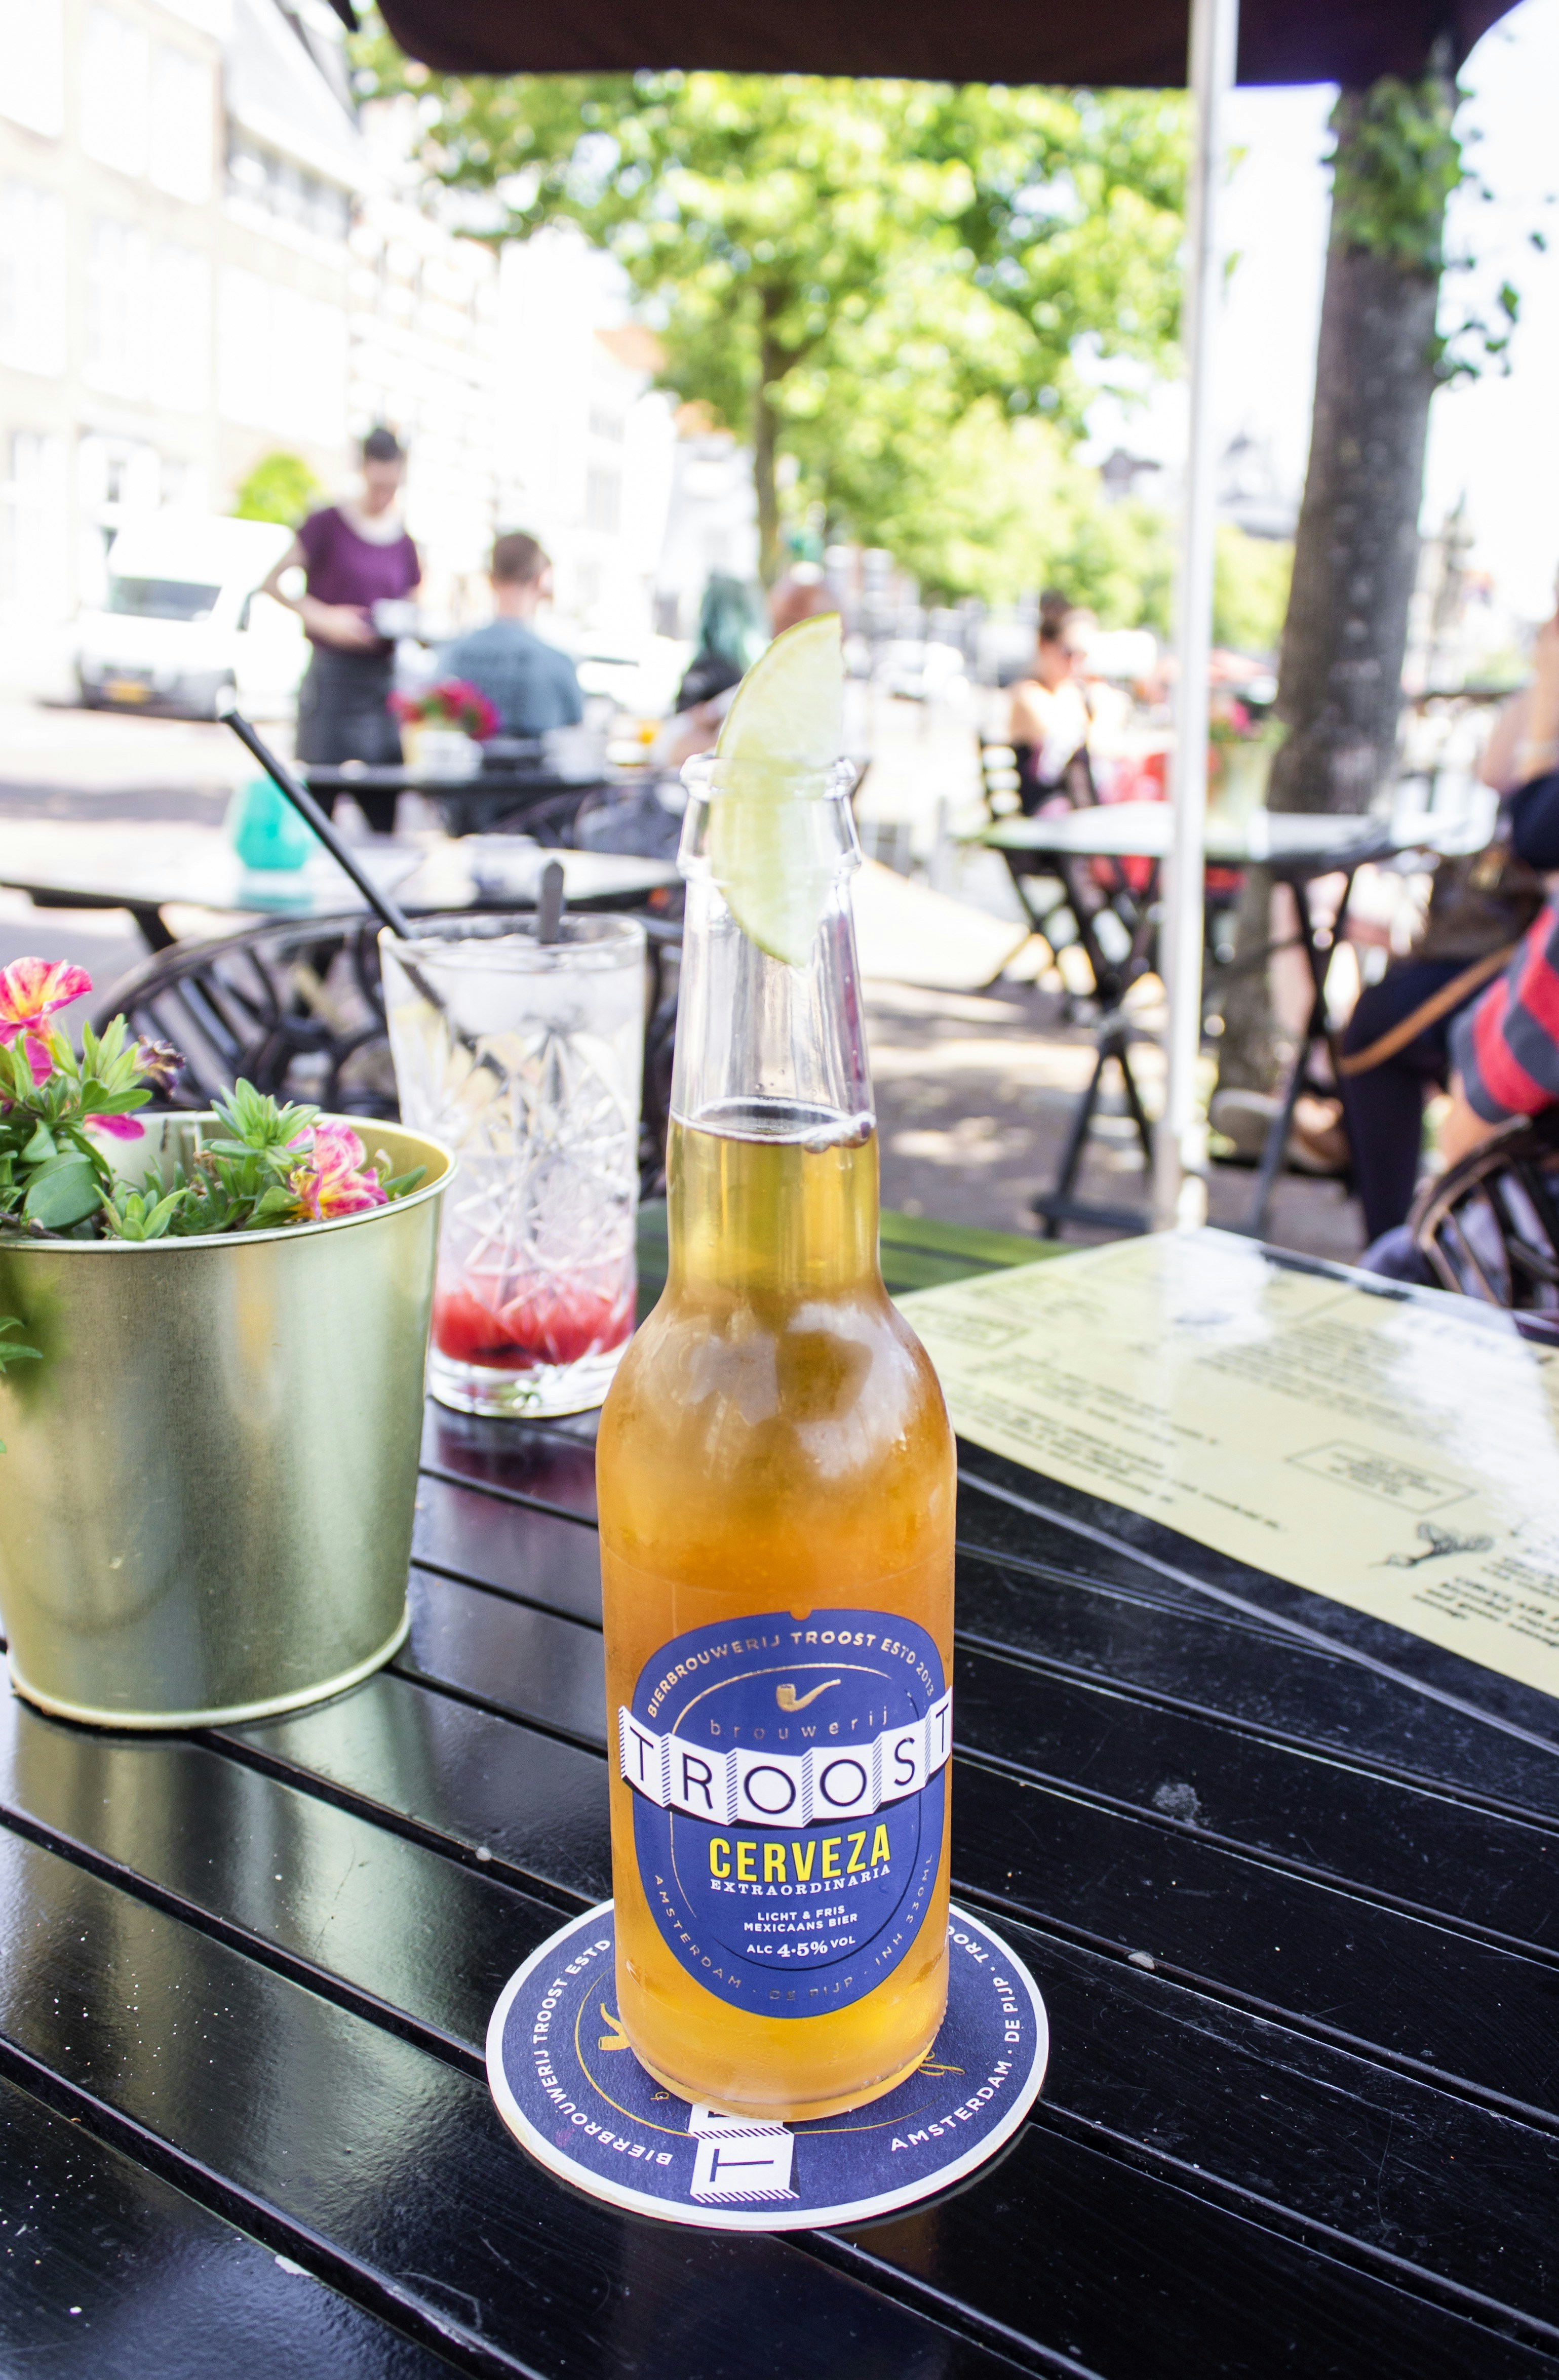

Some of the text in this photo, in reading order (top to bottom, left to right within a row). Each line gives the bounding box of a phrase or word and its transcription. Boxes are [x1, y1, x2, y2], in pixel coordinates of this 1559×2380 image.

[647, 1631, 934, 1718] BIERBROUWERIJ TROOST ESTD 2013
[710, 1705, 887, 1740] brouwerij
[629, 1702, 949, 1814] TROOST
[709, 1823, 891, 1883] CERVEZA
[710, 1864, 890, 1896] EXTRAORDINARIA
[654, 1854, 933, 2001] AMSTERDAM DE PIJP INH 330ML
[744, 1913, 858, 1932] MEXICAANS BIER
[757, 1905, 845, 1921] LICHT & FRIS
[564, 1938, 611, 1975] ESTD
[746, 1943, 773, 1954] ALC
[830, 1935, 856, 1948] VOL
[532, 1976, 568, 2044] TROOST
[993, 1977, 1019, 2014] PIJP
[1004, 2018, 1021, 2043] DE
[534, 2049, 674, 2166] BIERBROUWERIJ
[890, 2059, 1013, 2153] AMSTERDAM
